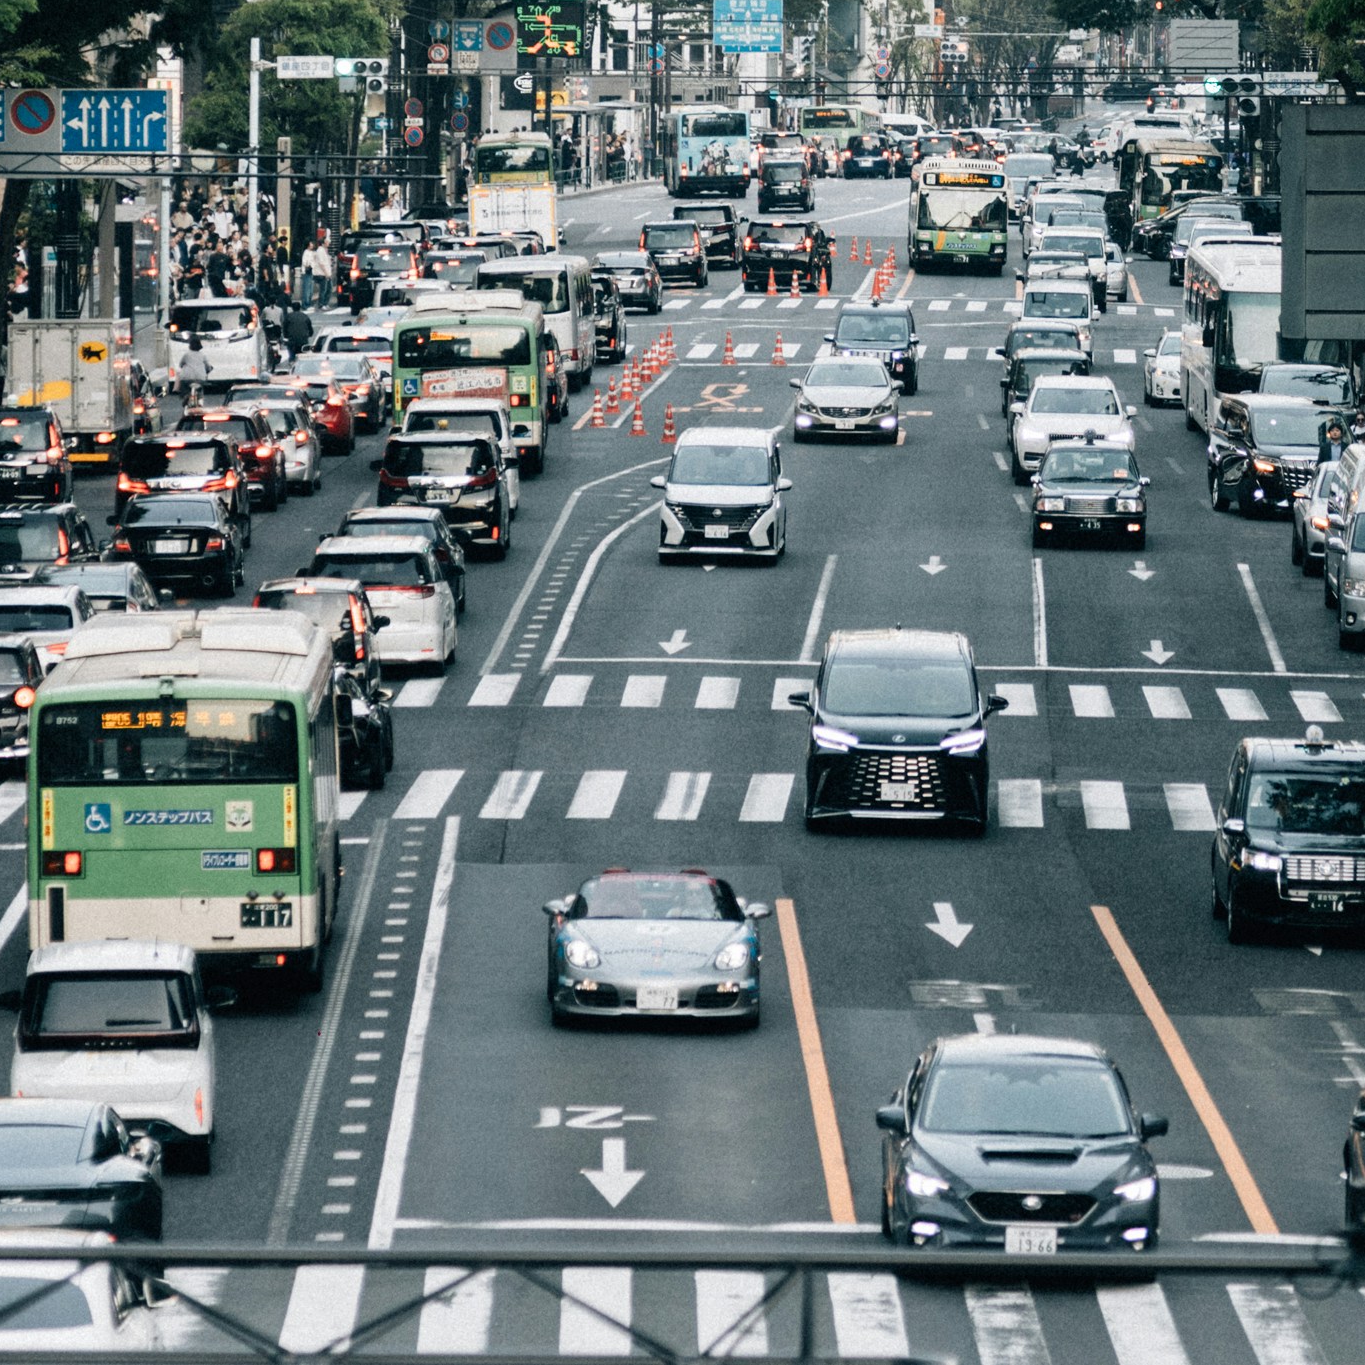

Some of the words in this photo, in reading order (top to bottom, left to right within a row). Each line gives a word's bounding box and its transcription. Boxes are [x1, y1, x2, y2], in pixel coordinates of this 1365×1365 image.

[124, 810, 212, 824] ノンステップバス
